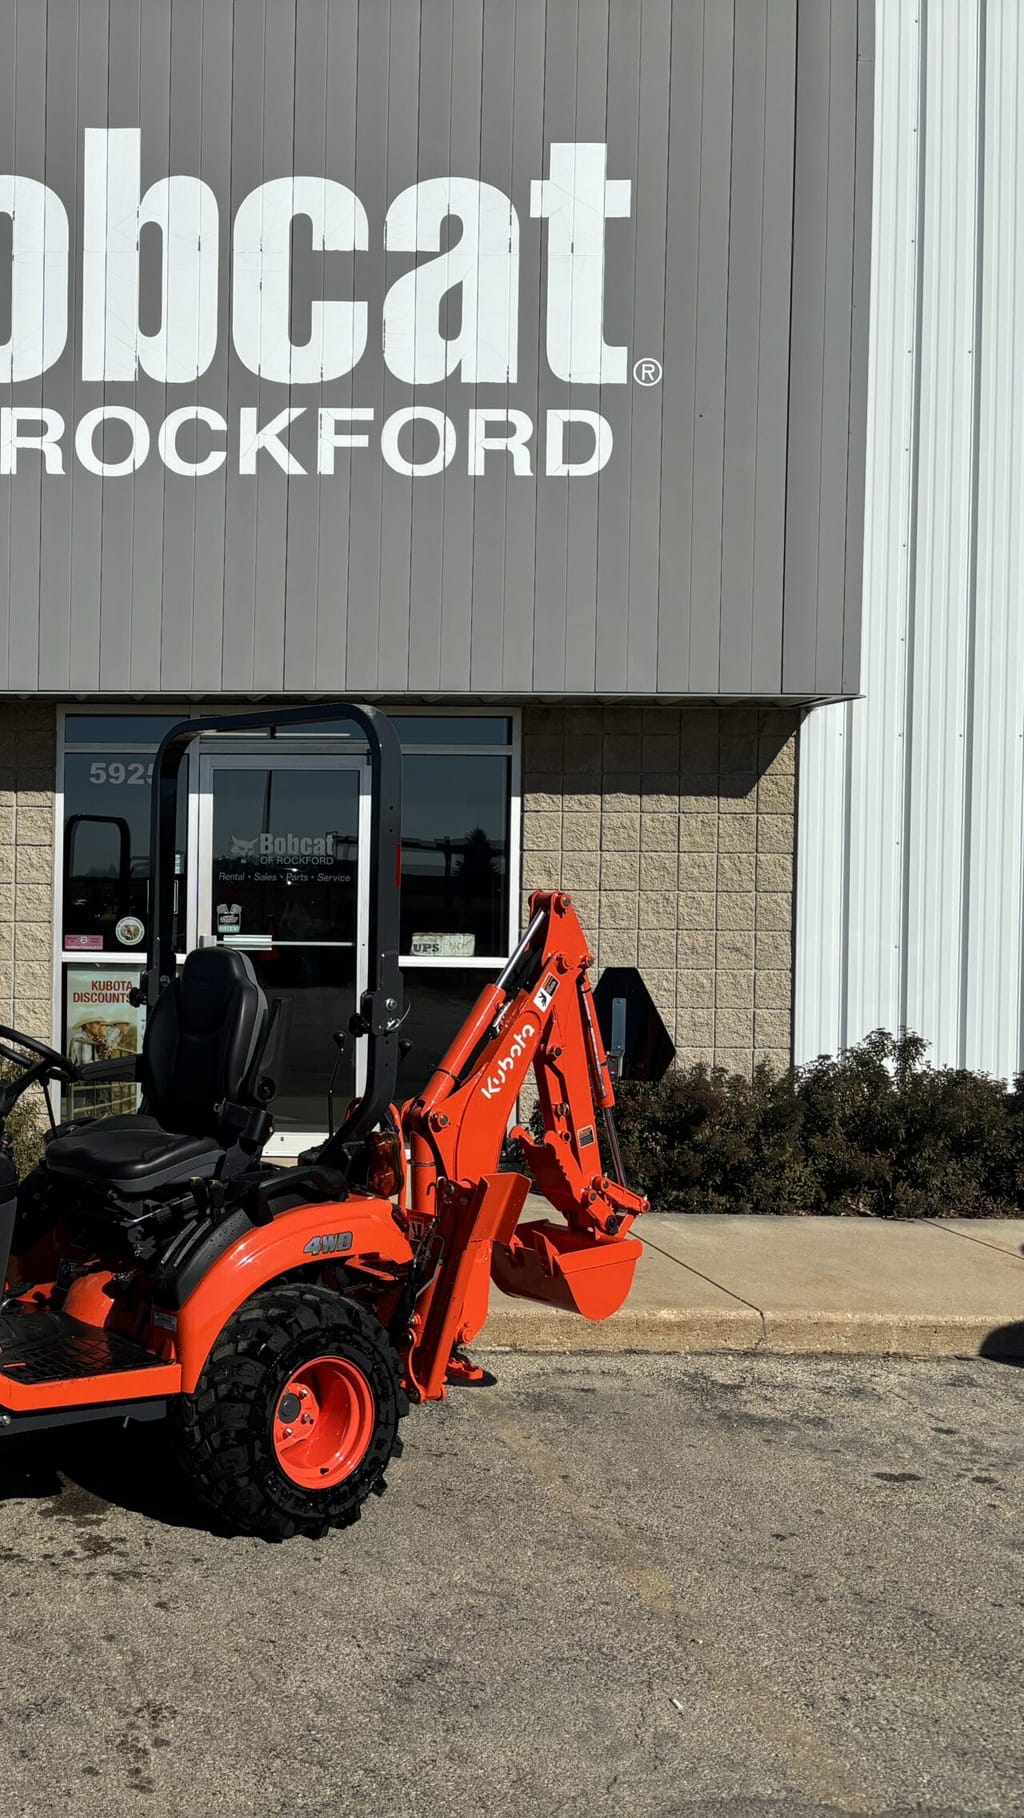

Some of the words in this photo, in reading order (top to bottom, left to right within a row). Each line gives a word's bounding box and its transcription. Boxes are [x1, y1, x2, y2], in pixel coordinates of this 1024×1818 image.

[0, 406, 613, 476] ROCKFORD
[259, 833, 334, 855] Bobcat
[260, 856, 274, 865] OF
[276, 856, 334, 865] ROCKFORD
[218, 872, 245, 880] Rental
[253, 872, 277, 881] Sales
[286, 872, 309, 881] Parts
[317, 873, 351, 882] Service
[413, 943, 440, 953] UPS
[91, 980, 133, 992] KUBOTA
[480, 1024, 536, 1100] Kubota
[303, 1231, 354, 1256] 4WD
